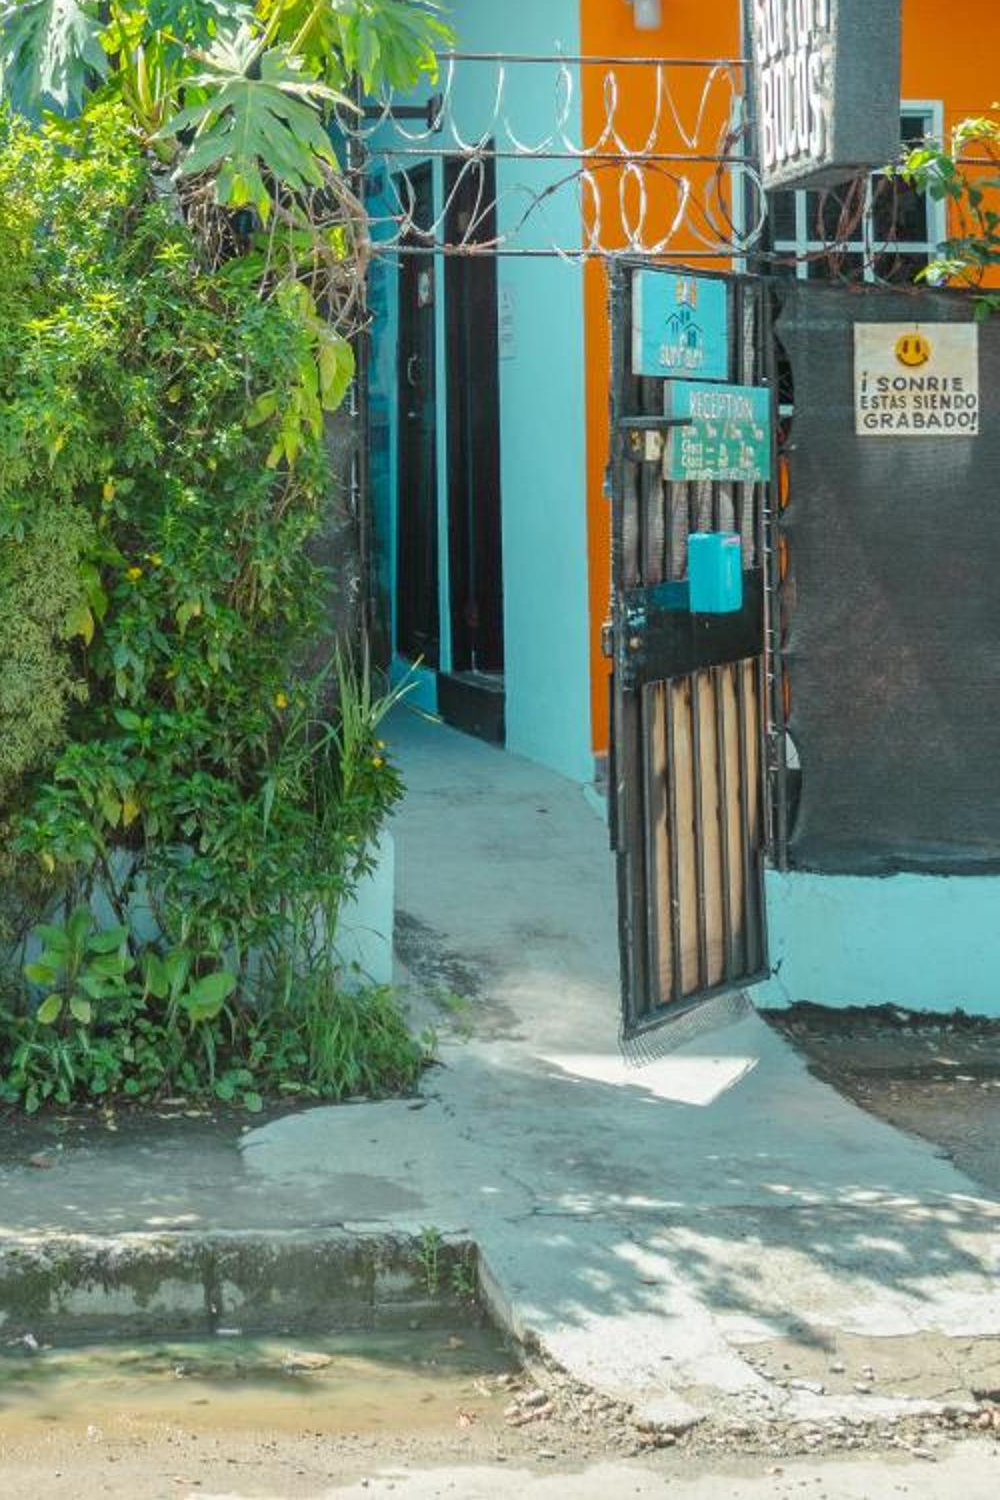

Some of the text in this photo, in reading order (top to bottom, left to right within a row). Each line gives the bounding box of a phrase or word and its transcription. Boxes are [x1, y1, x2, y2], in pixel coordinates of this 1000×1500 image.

[876, 376, 963, 393] SONRIE
[690, 390, 754, 420] RECEPTION
[861, 393, 977, 410] ESTAS SIENDO
[863, 411, 977, 431] GRABADO!
